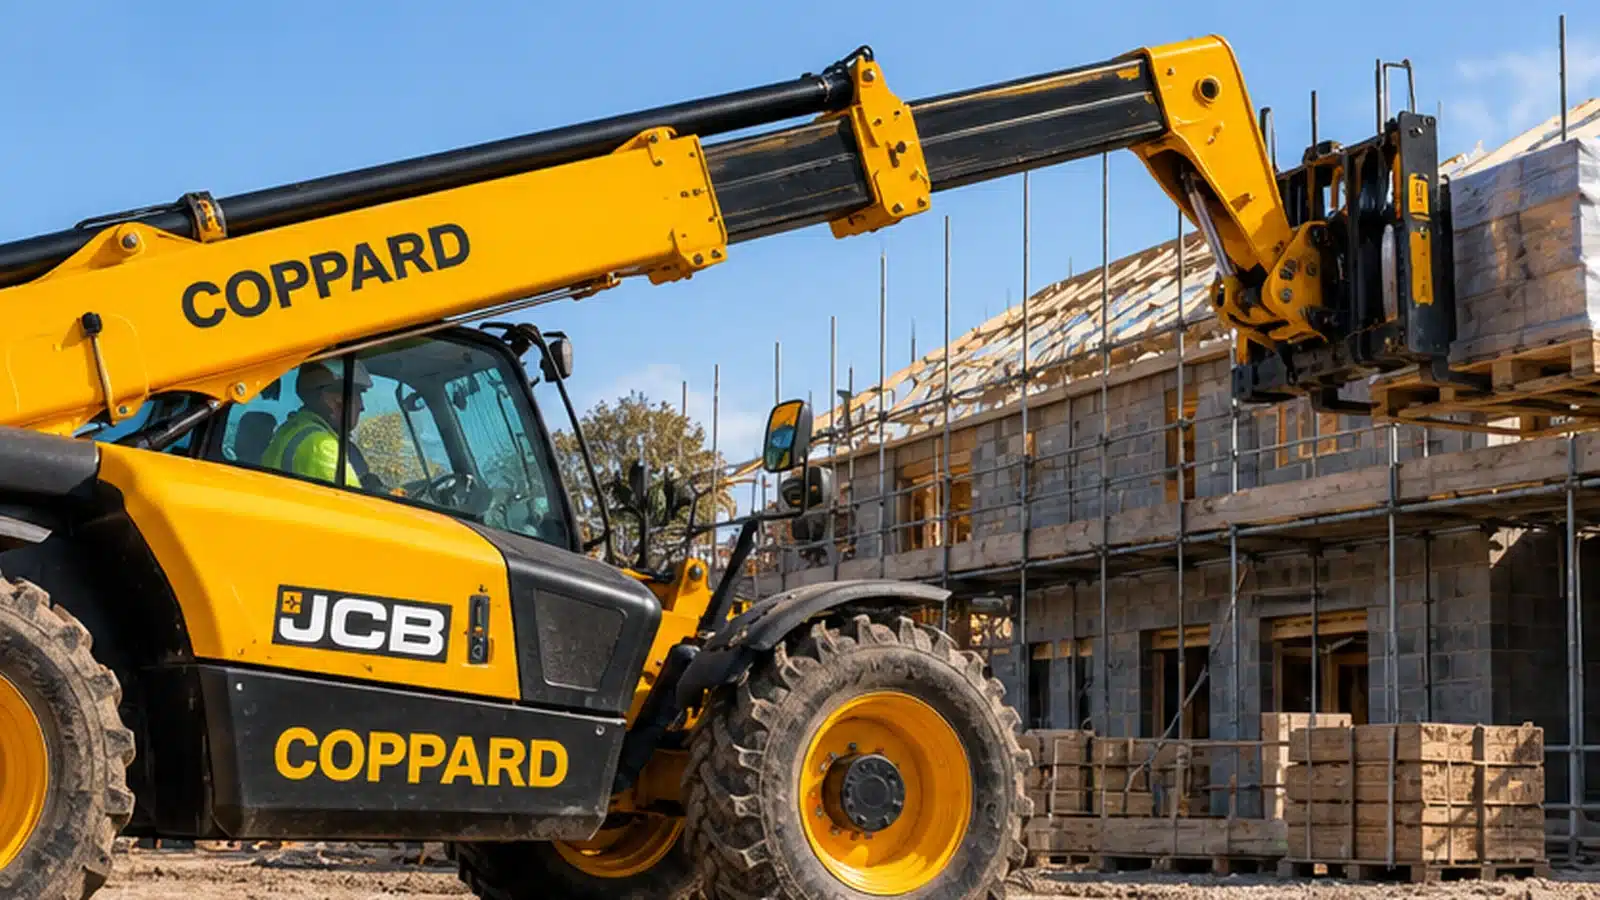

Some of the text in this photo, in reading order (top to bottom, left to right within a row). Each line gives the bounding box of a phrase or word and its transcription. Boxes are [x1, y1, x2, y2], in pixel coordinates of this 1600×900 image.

[182, 223, 470, 328] COPPARD
[279, 595, 445, 656] JCB
[274, 727, 569, 788] COPPARD
